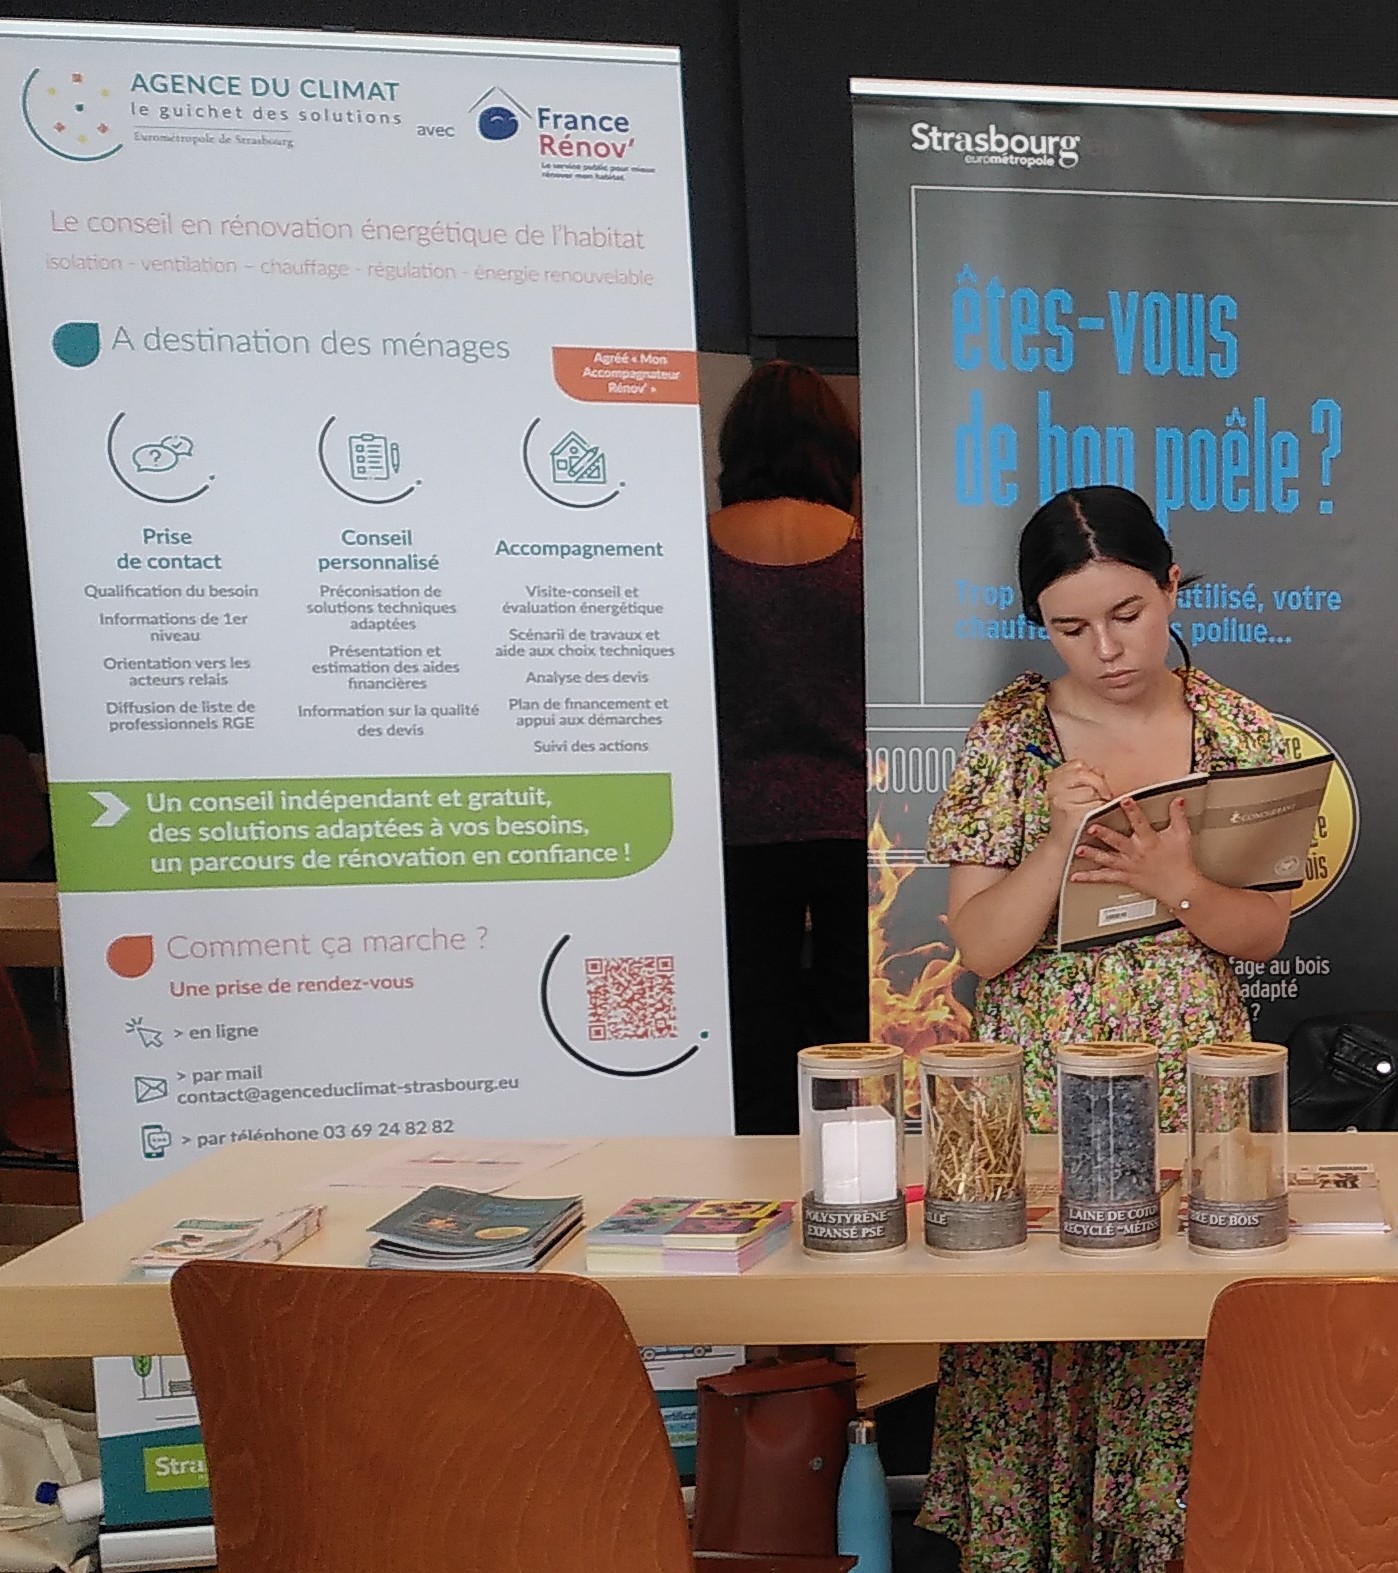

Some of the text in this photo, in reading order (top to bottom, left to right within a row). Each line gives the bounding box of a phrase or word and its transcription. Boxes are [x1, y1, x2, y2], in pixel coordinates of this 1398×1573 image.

[129, 72, 400, 102] AGENCE DU CLIMAT
[129, 100, 402, 125] le guichet des solutions
[536, 106, 629, 133] France
[416, 124, 455, 138] avec
[910, 121, 1081, 169] Strasbourg
[964, 153, 1055, 168] eurométropole
[49, 208, 79, 233] Le
[85, 211, 173, 234] conseil
[180, 217, 212, 235] en
[220, 213, 353, 239] rénovation
[360, 216, 507, 248] énergétique
[514, 222, 545, 246] de
[41, 251, 654, 286] isolation ventilation chauffage régulation énergie renouvelable
[951, 262, 1239, 379] êtes-vous
[110, 324, 510, 364] A destination des ménages
[592, 351, 668, 366] Agréé Mon
[581, 365, 680, 381] Accompagnateur
[952, 389, 1343, 538] de bon poêle ?
[142, 526, 192, 545] Prise
[340, 528, 413, 546] Conseil
[116, 551, 222, 570] de contact
[494, 539, 664, 560] Accompagnement
[317, 552, 440, 573] personnalisé
[83, 583, 259, 600] Qualification du besoin
[954, 578, 1016, 610] Trop
[1273, 586, 1343, 612] votre
[532, 738, 649, 753] Suivi des actions
[145, 785, 552, 813] Un conseil indépendant et gratuit,
[148, 813, 589, 843] des solutions adaptées à vos besoins,
[150, 842, 618, 876] un parcours de rénovation en confiance
[165, 926, 466, 960] Comment ça marche
[1269, 959, 1291, 976] au
[1294, 955, 1331, 976] bois
[168, 974, 414, 999] Une prise de rendez-vous
[1240, 977, 1299, 1003] adapté
[188, 1022, 259, 1042] en ligne
[191, 1063, 263, 1086] par mail
[176, 1076, 519, 1105] contact@agenceduclimat-strasbourg.eu
[196, 1133, 227, 1149] par
[322, 1123, 346, 1140] 03
[350, 1122, 373, 1138] 69
[377, 1121, 401, 1137] 24
[404, 1119, 427, 1136] 82
[430, 1118, 455, 1134] 82
[806, 1210, 889, 1225] POLYSTYRÈNE
[1069, 1208, 1127, 1222] LAINE DE
[1209, 1214, 1227, 1226] DE
[1229, 1214, 1260, 1227] BOIS
[807, 1225, 885, 1239] EXPANSÉ PSE
[1063, 1221, 1116, 1236] RECYCLÉ
